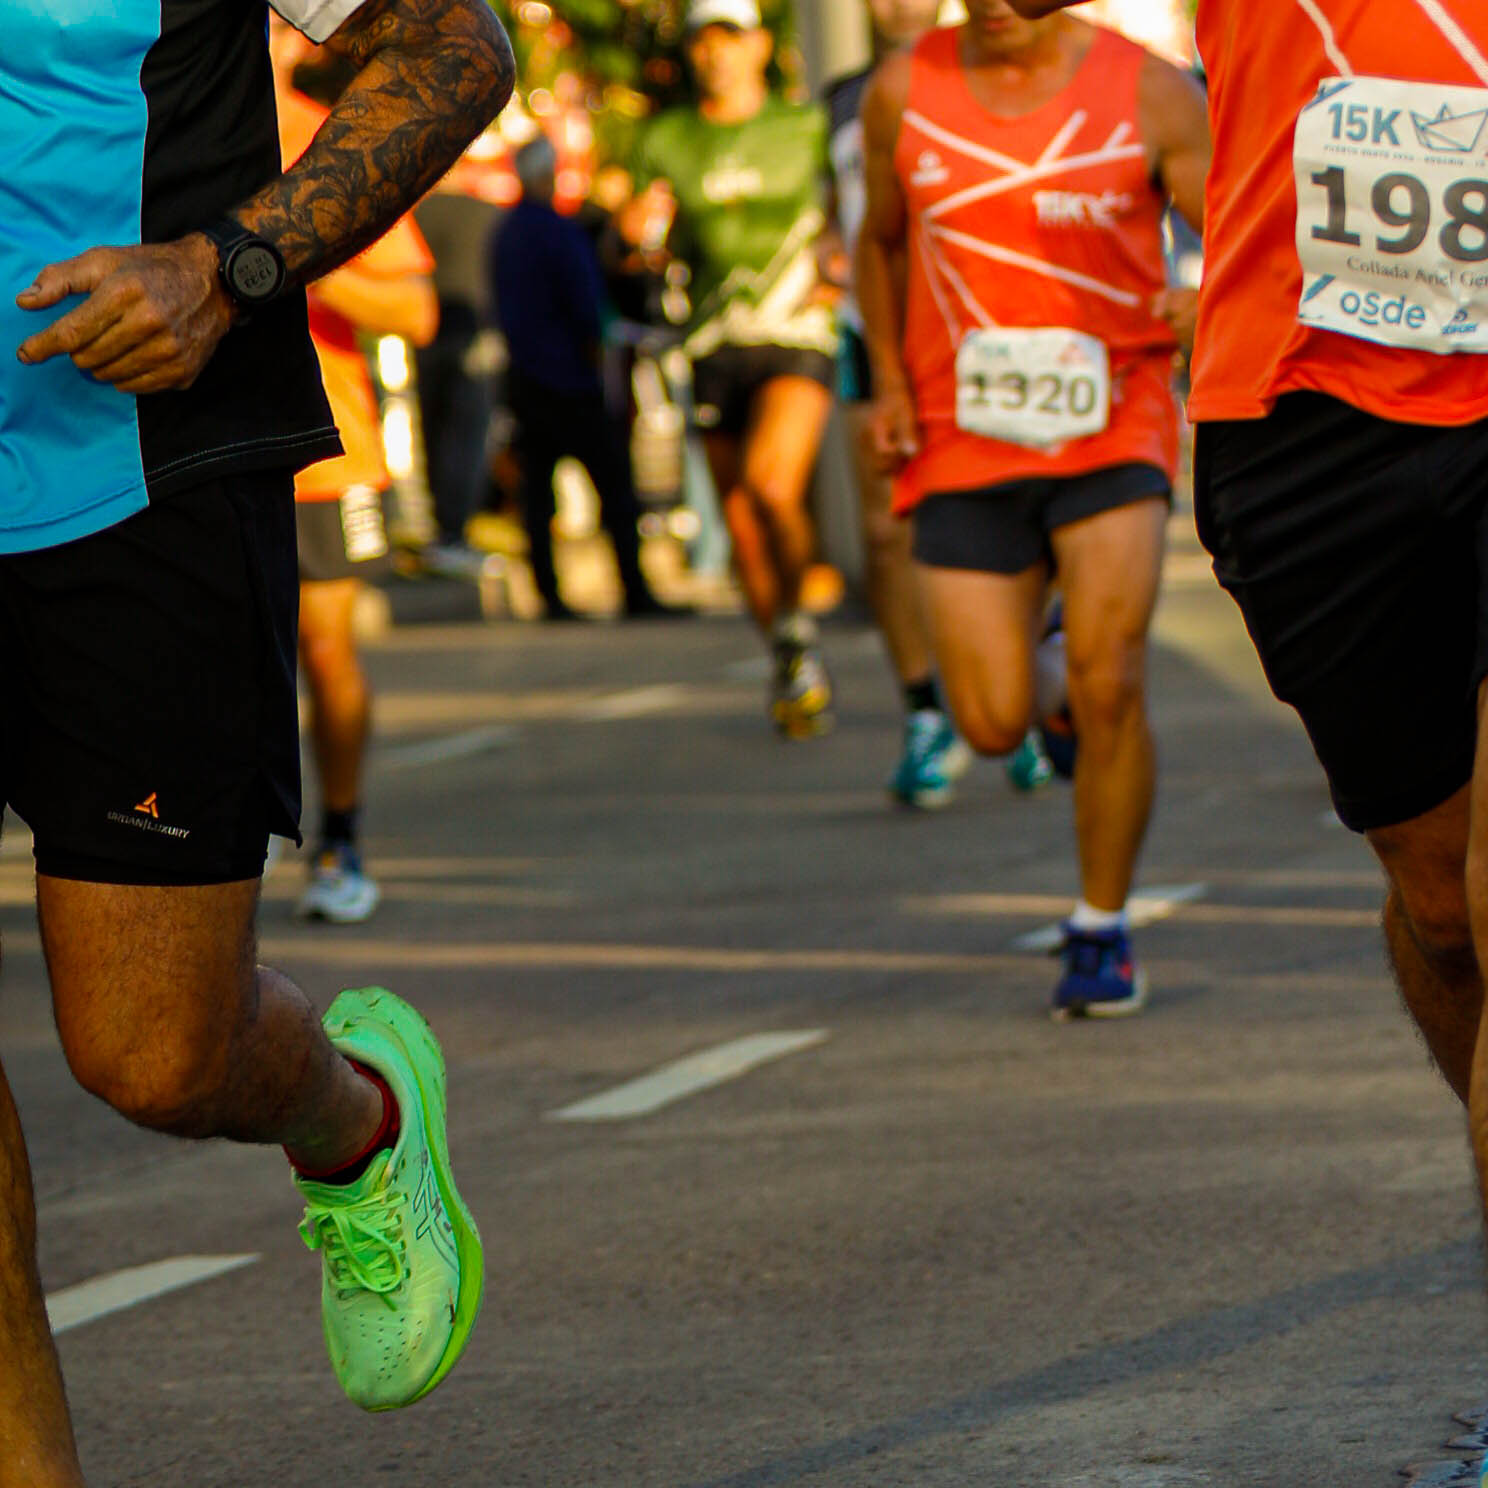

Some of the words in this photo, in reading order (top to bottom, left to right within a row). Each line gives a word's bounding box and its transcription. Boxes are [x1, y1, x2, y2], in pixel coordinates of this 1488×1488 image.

[1328, 102, 1401, 147] 15K
[1340, 290, 1426, 329] osde
[966, 371, 1098, 417] 1320
